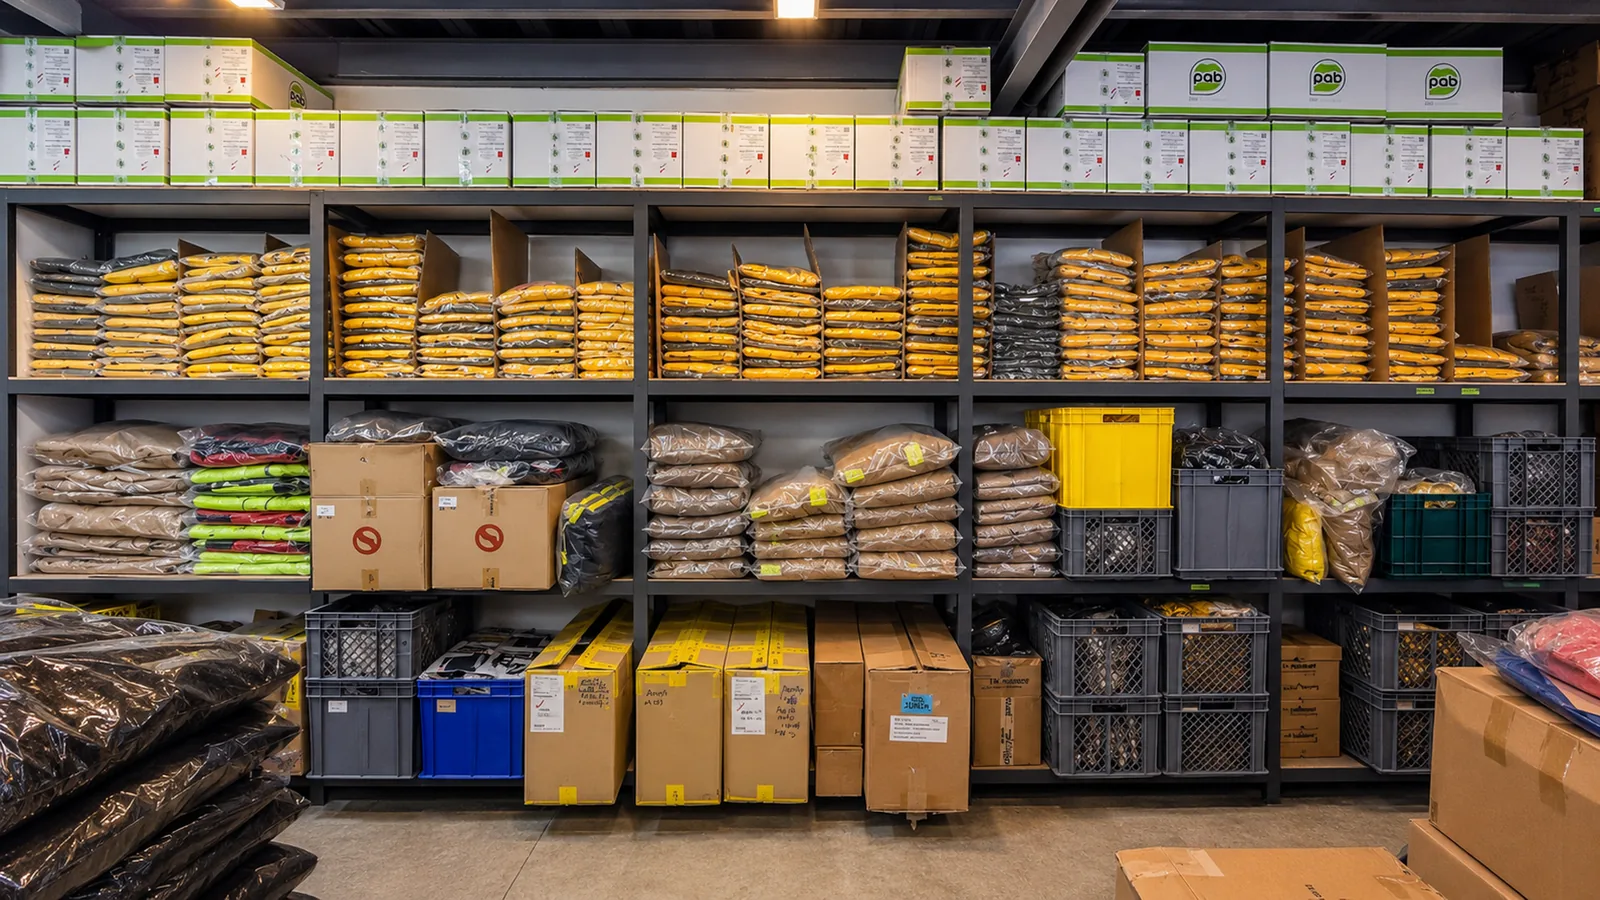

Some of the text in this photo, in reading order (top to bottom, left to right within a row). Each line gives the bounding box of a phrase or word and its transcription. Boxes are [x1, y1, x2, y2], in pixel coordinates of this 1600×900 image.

[1193, 71, 1223, 85] pab
[1313, 72, 1343, 85] pab
[1428, 76, 1458, 89] pab
